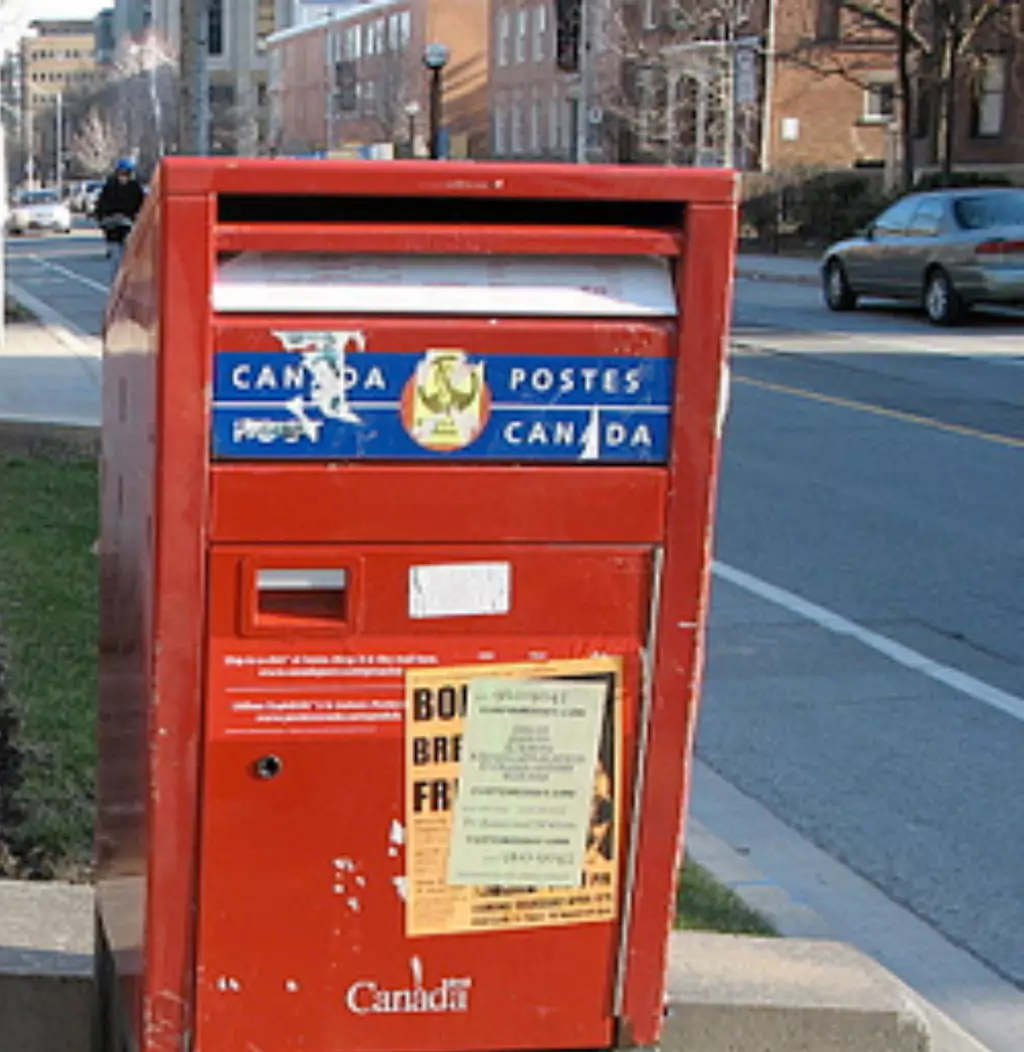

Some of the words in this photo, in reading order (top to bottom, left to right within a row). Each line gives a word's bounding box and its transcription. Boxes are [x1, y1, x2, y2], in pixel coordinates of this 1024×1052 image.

[232, 364, 386, 391] CANDA
[510, 367, 642, 394] POSTES
[413, 776, 459, 813] FR
[346, 976, 472, 1014] Canada
